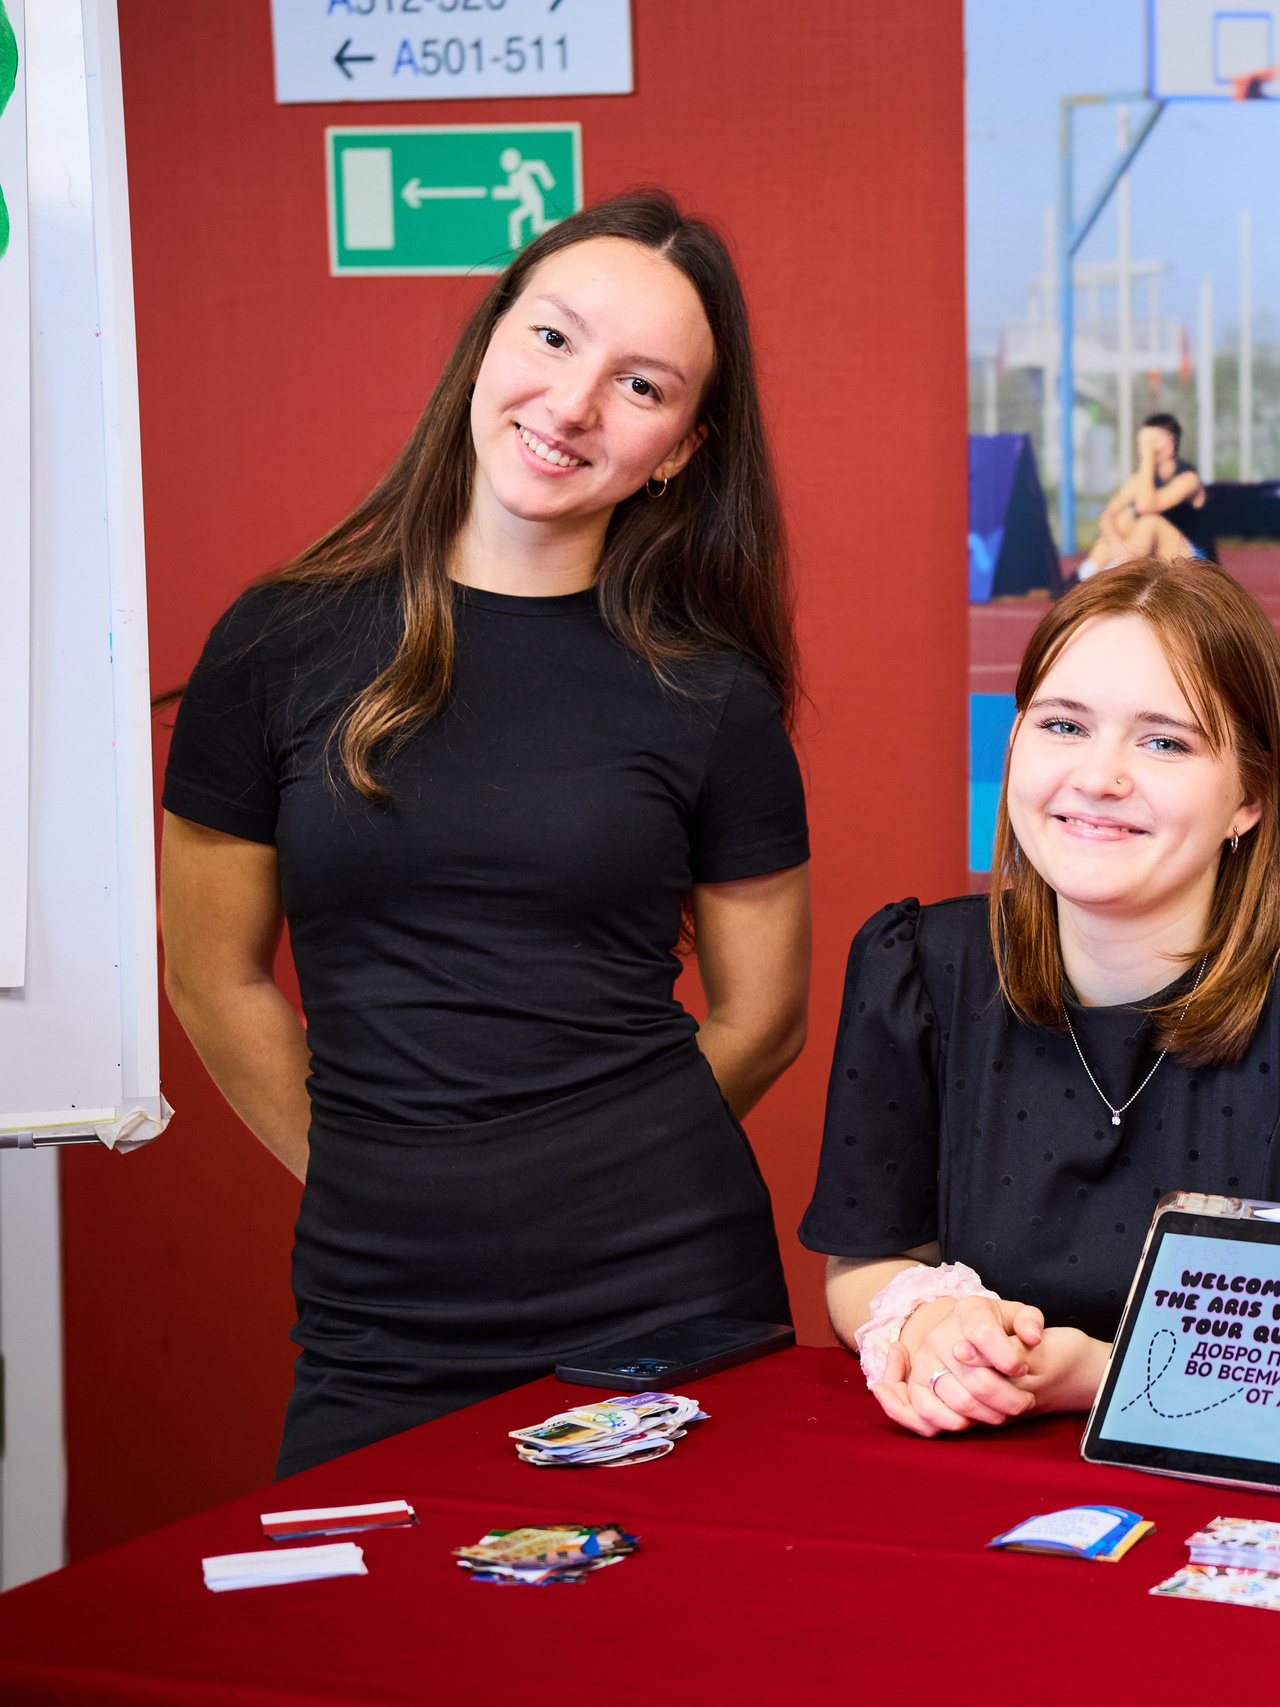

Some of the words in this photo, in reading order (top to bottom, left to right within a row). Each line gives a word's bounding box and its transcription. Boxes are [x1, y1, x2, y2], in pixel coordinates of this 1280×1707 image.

[393, 35, 569, 76] A501-511
[1154, 1290, 1200, 1310] THE
[1207, 1296, 1262, 1318] ARIS
[1181, 1316, 1243, 1339] TOUR
[1190, 1342, 1262, 1364] ДОБРО
[1184, 1360, 1212, 1377] ВО
[1245, 1388, 1273, 1404] ОТ
